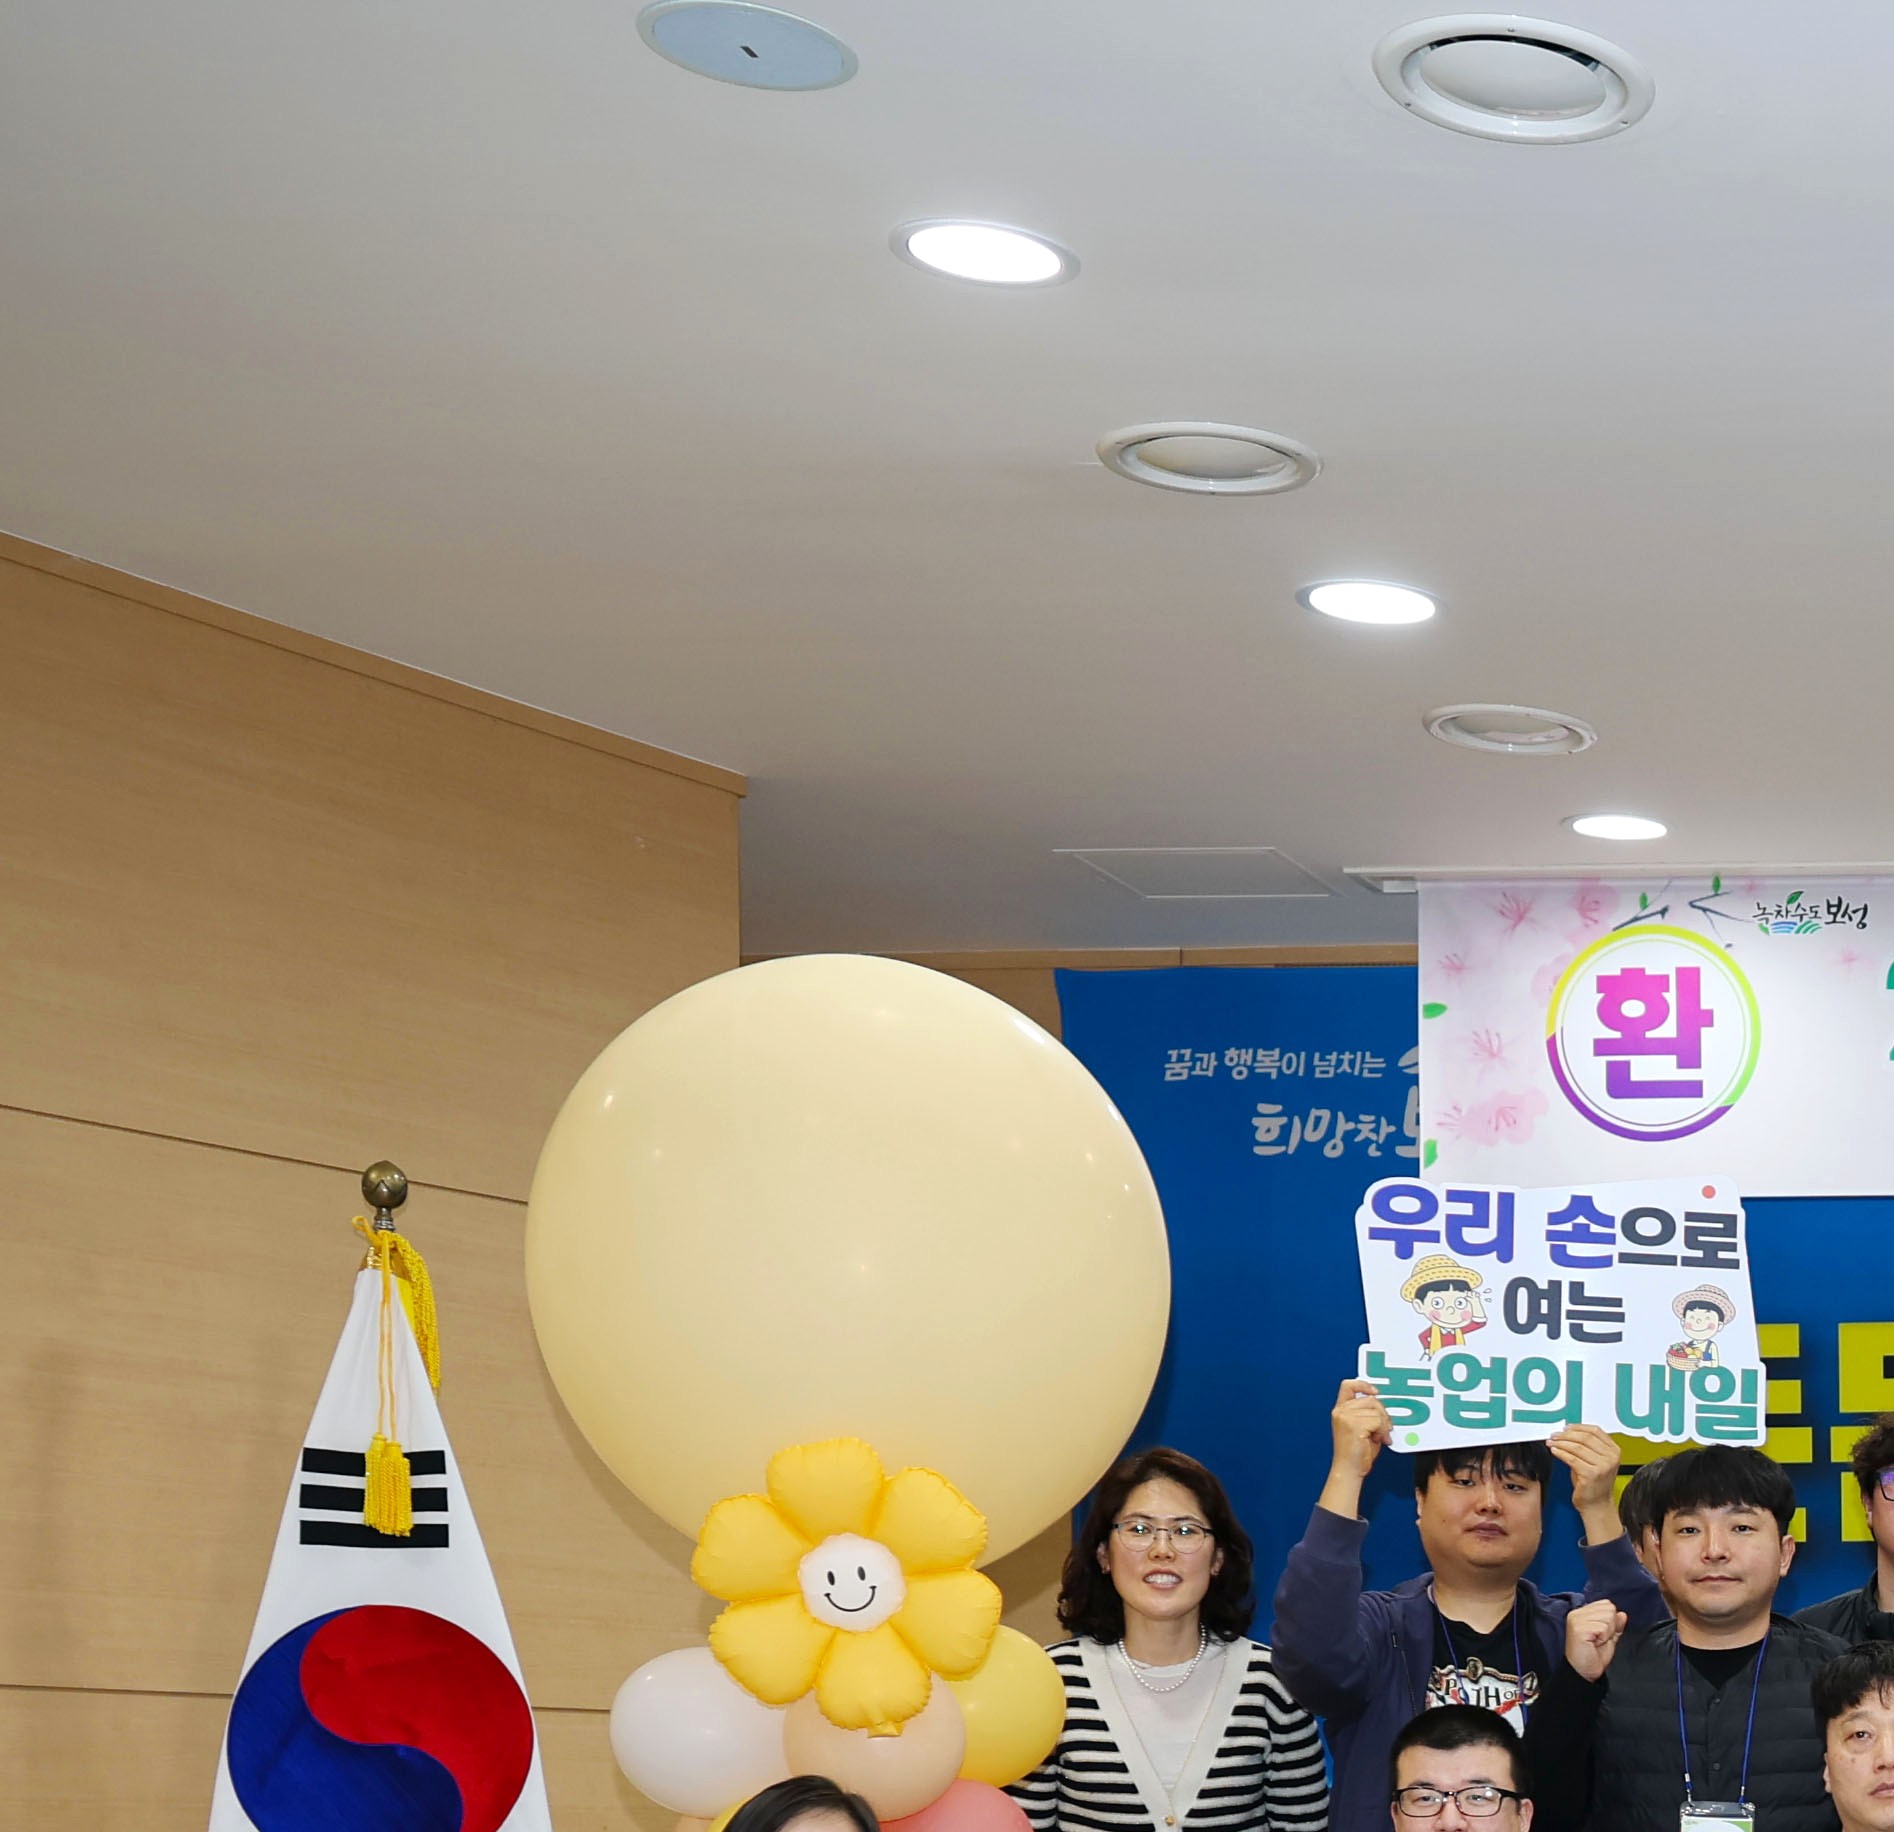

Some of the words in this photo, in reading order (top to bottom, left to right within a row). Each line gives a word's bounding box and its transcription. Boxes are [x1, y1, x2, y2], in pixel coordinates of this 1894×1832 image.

[1752, 902, 1822, 925] 녹차수도
[1824, 895, 1868, 930] 보성
[1164, 1048, 1218, 1081] 꿈과
[1223, 1047, 1306, 1080] 행복이
[1312, 1050, 1386, 1078] 넘치는
[1595, 965, 1715, 1101] 환
[1251, 1102, 1396, 1158] 희망찬
[1367, 1183, 1515, 1264] 우리
[1545, 1191, 1741, 1271] 손으로
[1502, 1276, 1626, 1347] 여는
[1365, 1350, 1585, 1432] 농업의
[1614, 1362, 1760, 1440] 내일
[1445, 1678, 1501, 1708] PTH
